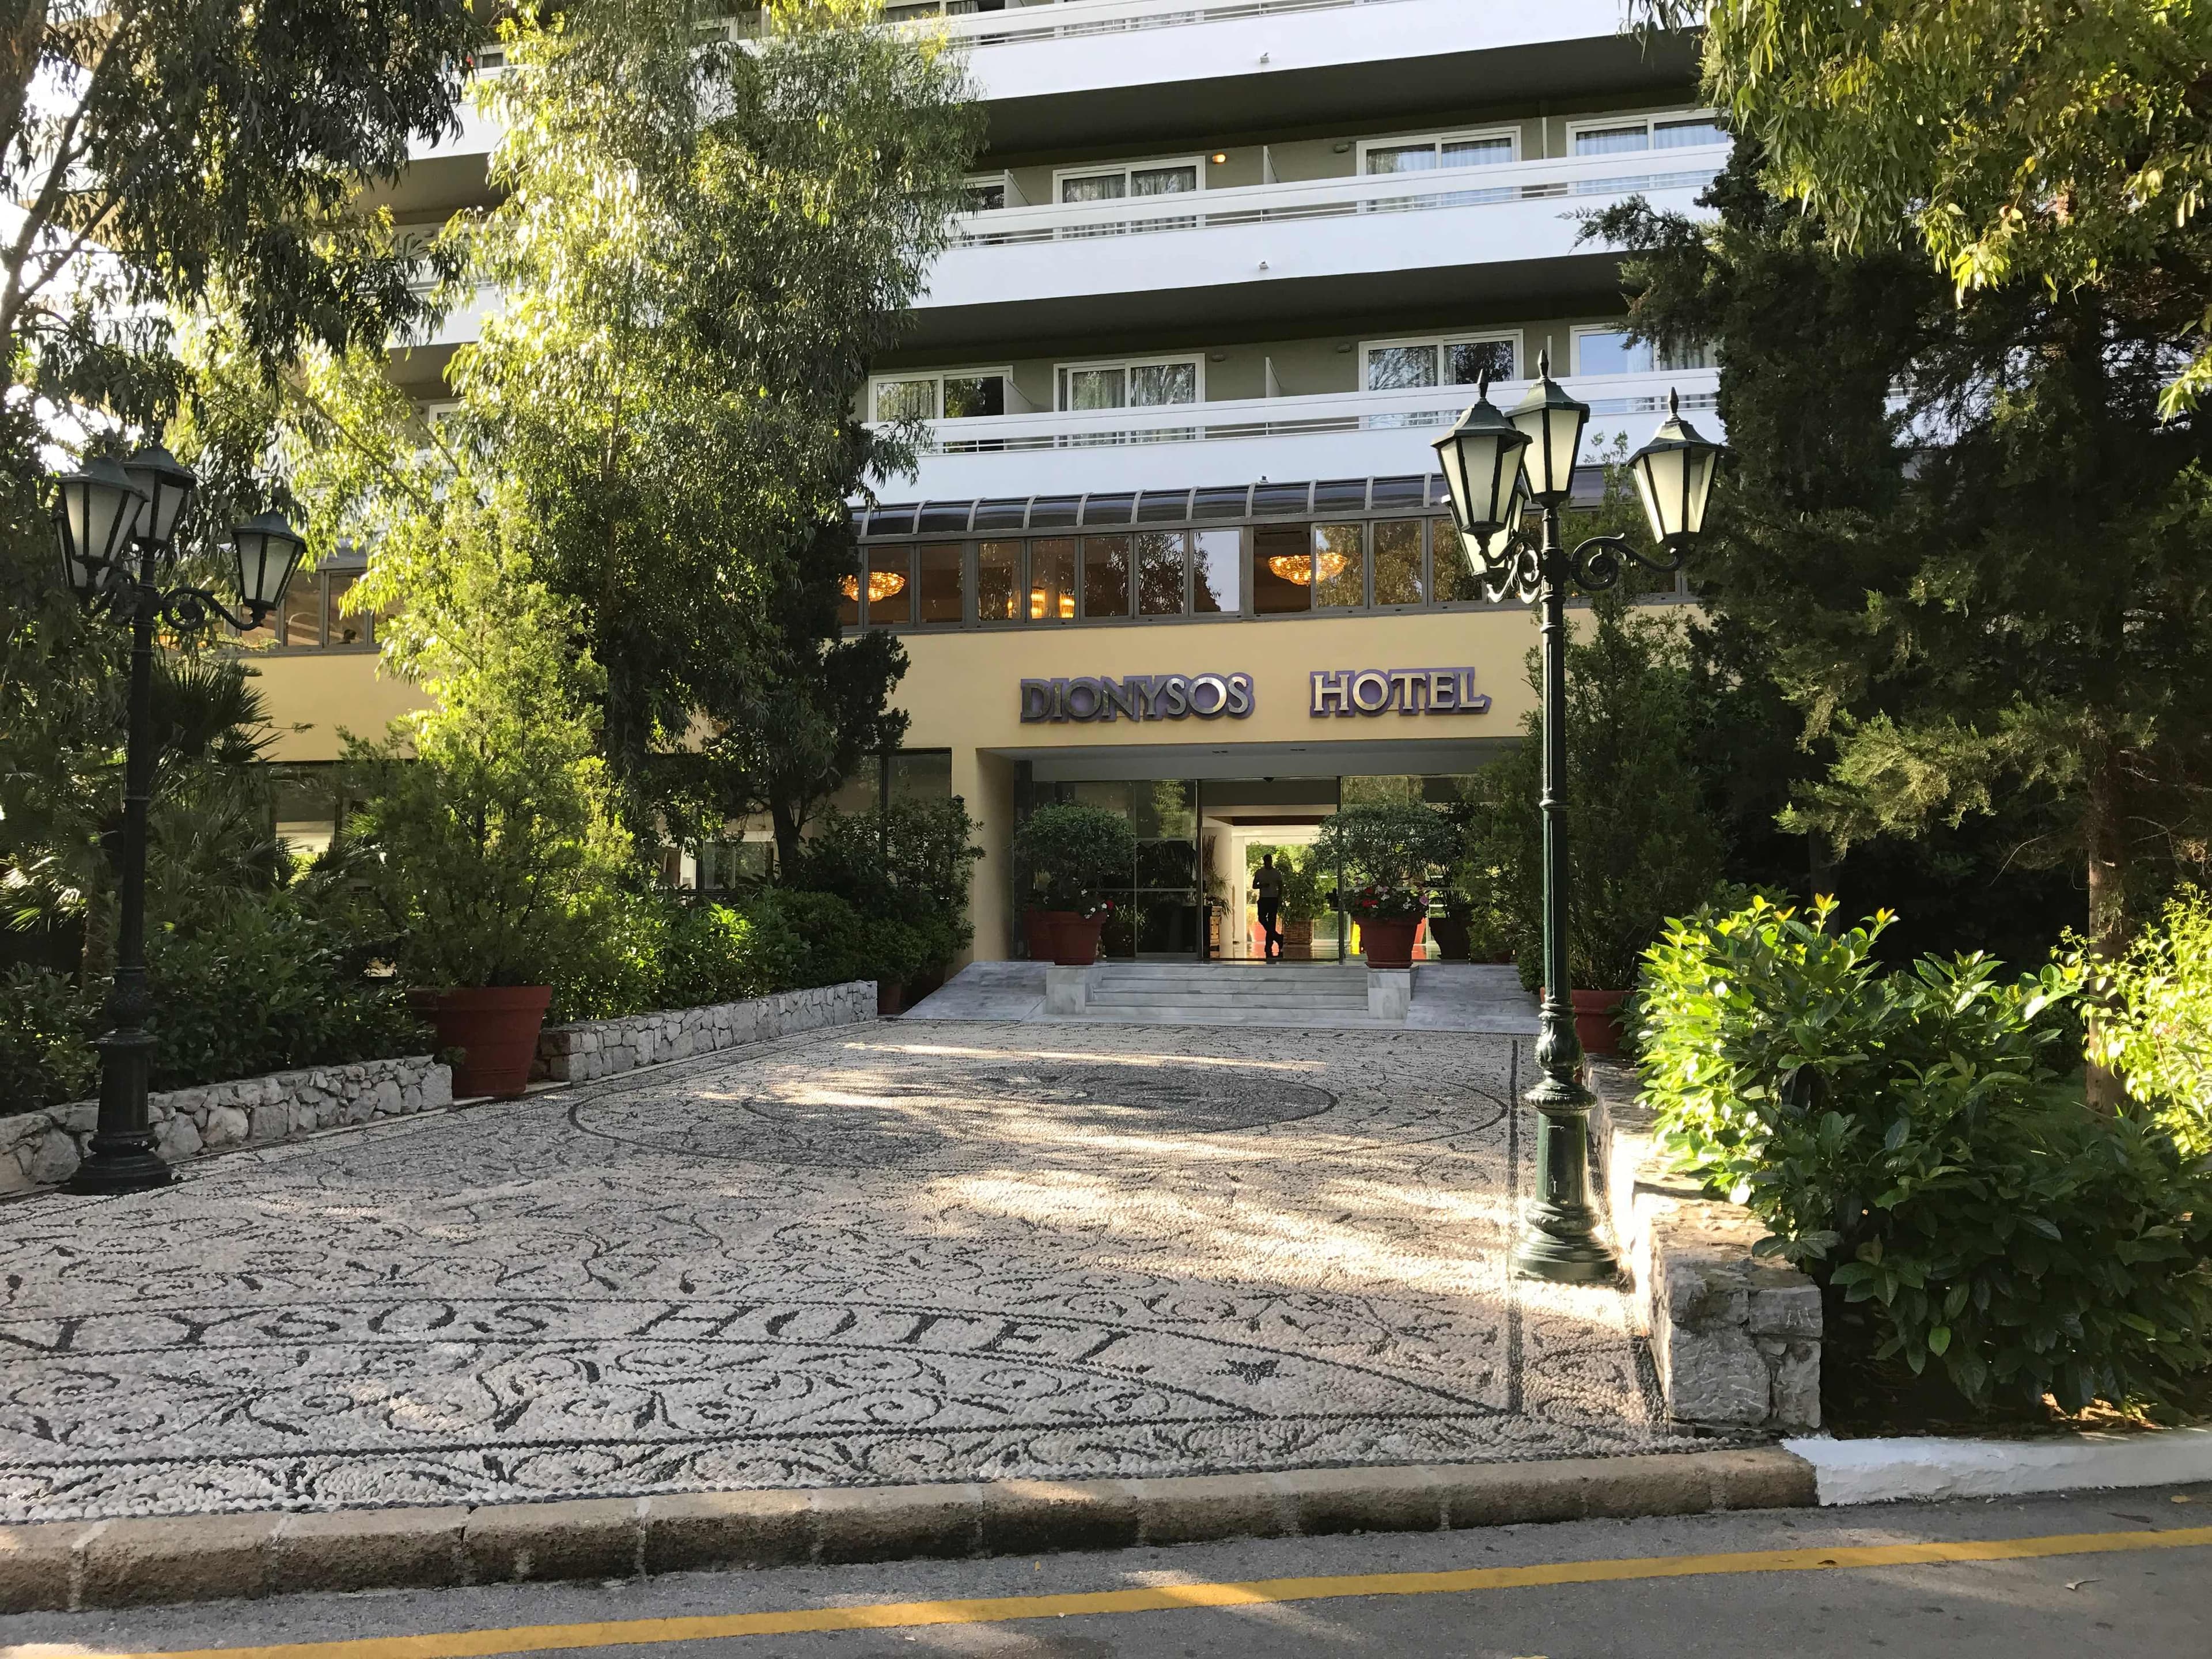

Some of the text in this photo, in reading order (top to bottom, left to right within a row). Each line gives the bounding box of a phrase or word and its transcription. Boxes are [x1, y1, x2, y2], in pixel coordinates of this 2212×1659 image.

[1022, 671, 1486, 719] DIONYSOS HOTEL
[622, 1304, 1153, 1373] HOTEL
